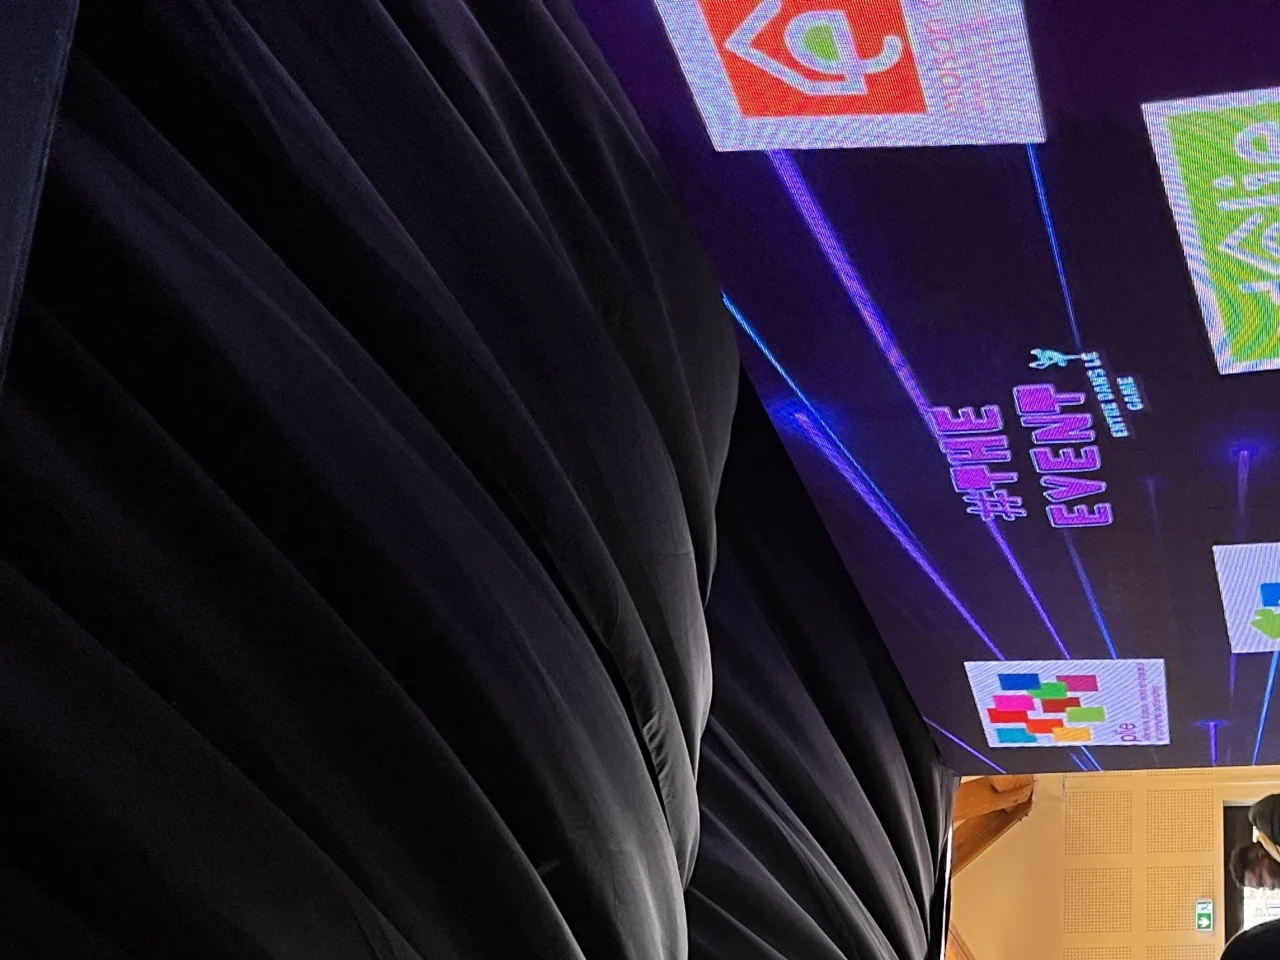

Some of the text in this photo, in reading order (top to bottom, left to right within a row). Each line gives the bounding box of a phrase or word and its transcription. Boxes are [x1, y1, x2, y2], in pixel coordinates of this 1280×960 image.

[1081, 352, 1130, 438] ENTRE DANS LE
[1116, 376, 1144, 411] GAME
[928, 404, 1027, 522] #THE
[1012, 384, 1114, 528] EVENT
[1114, 722, 1141, 742] plie
